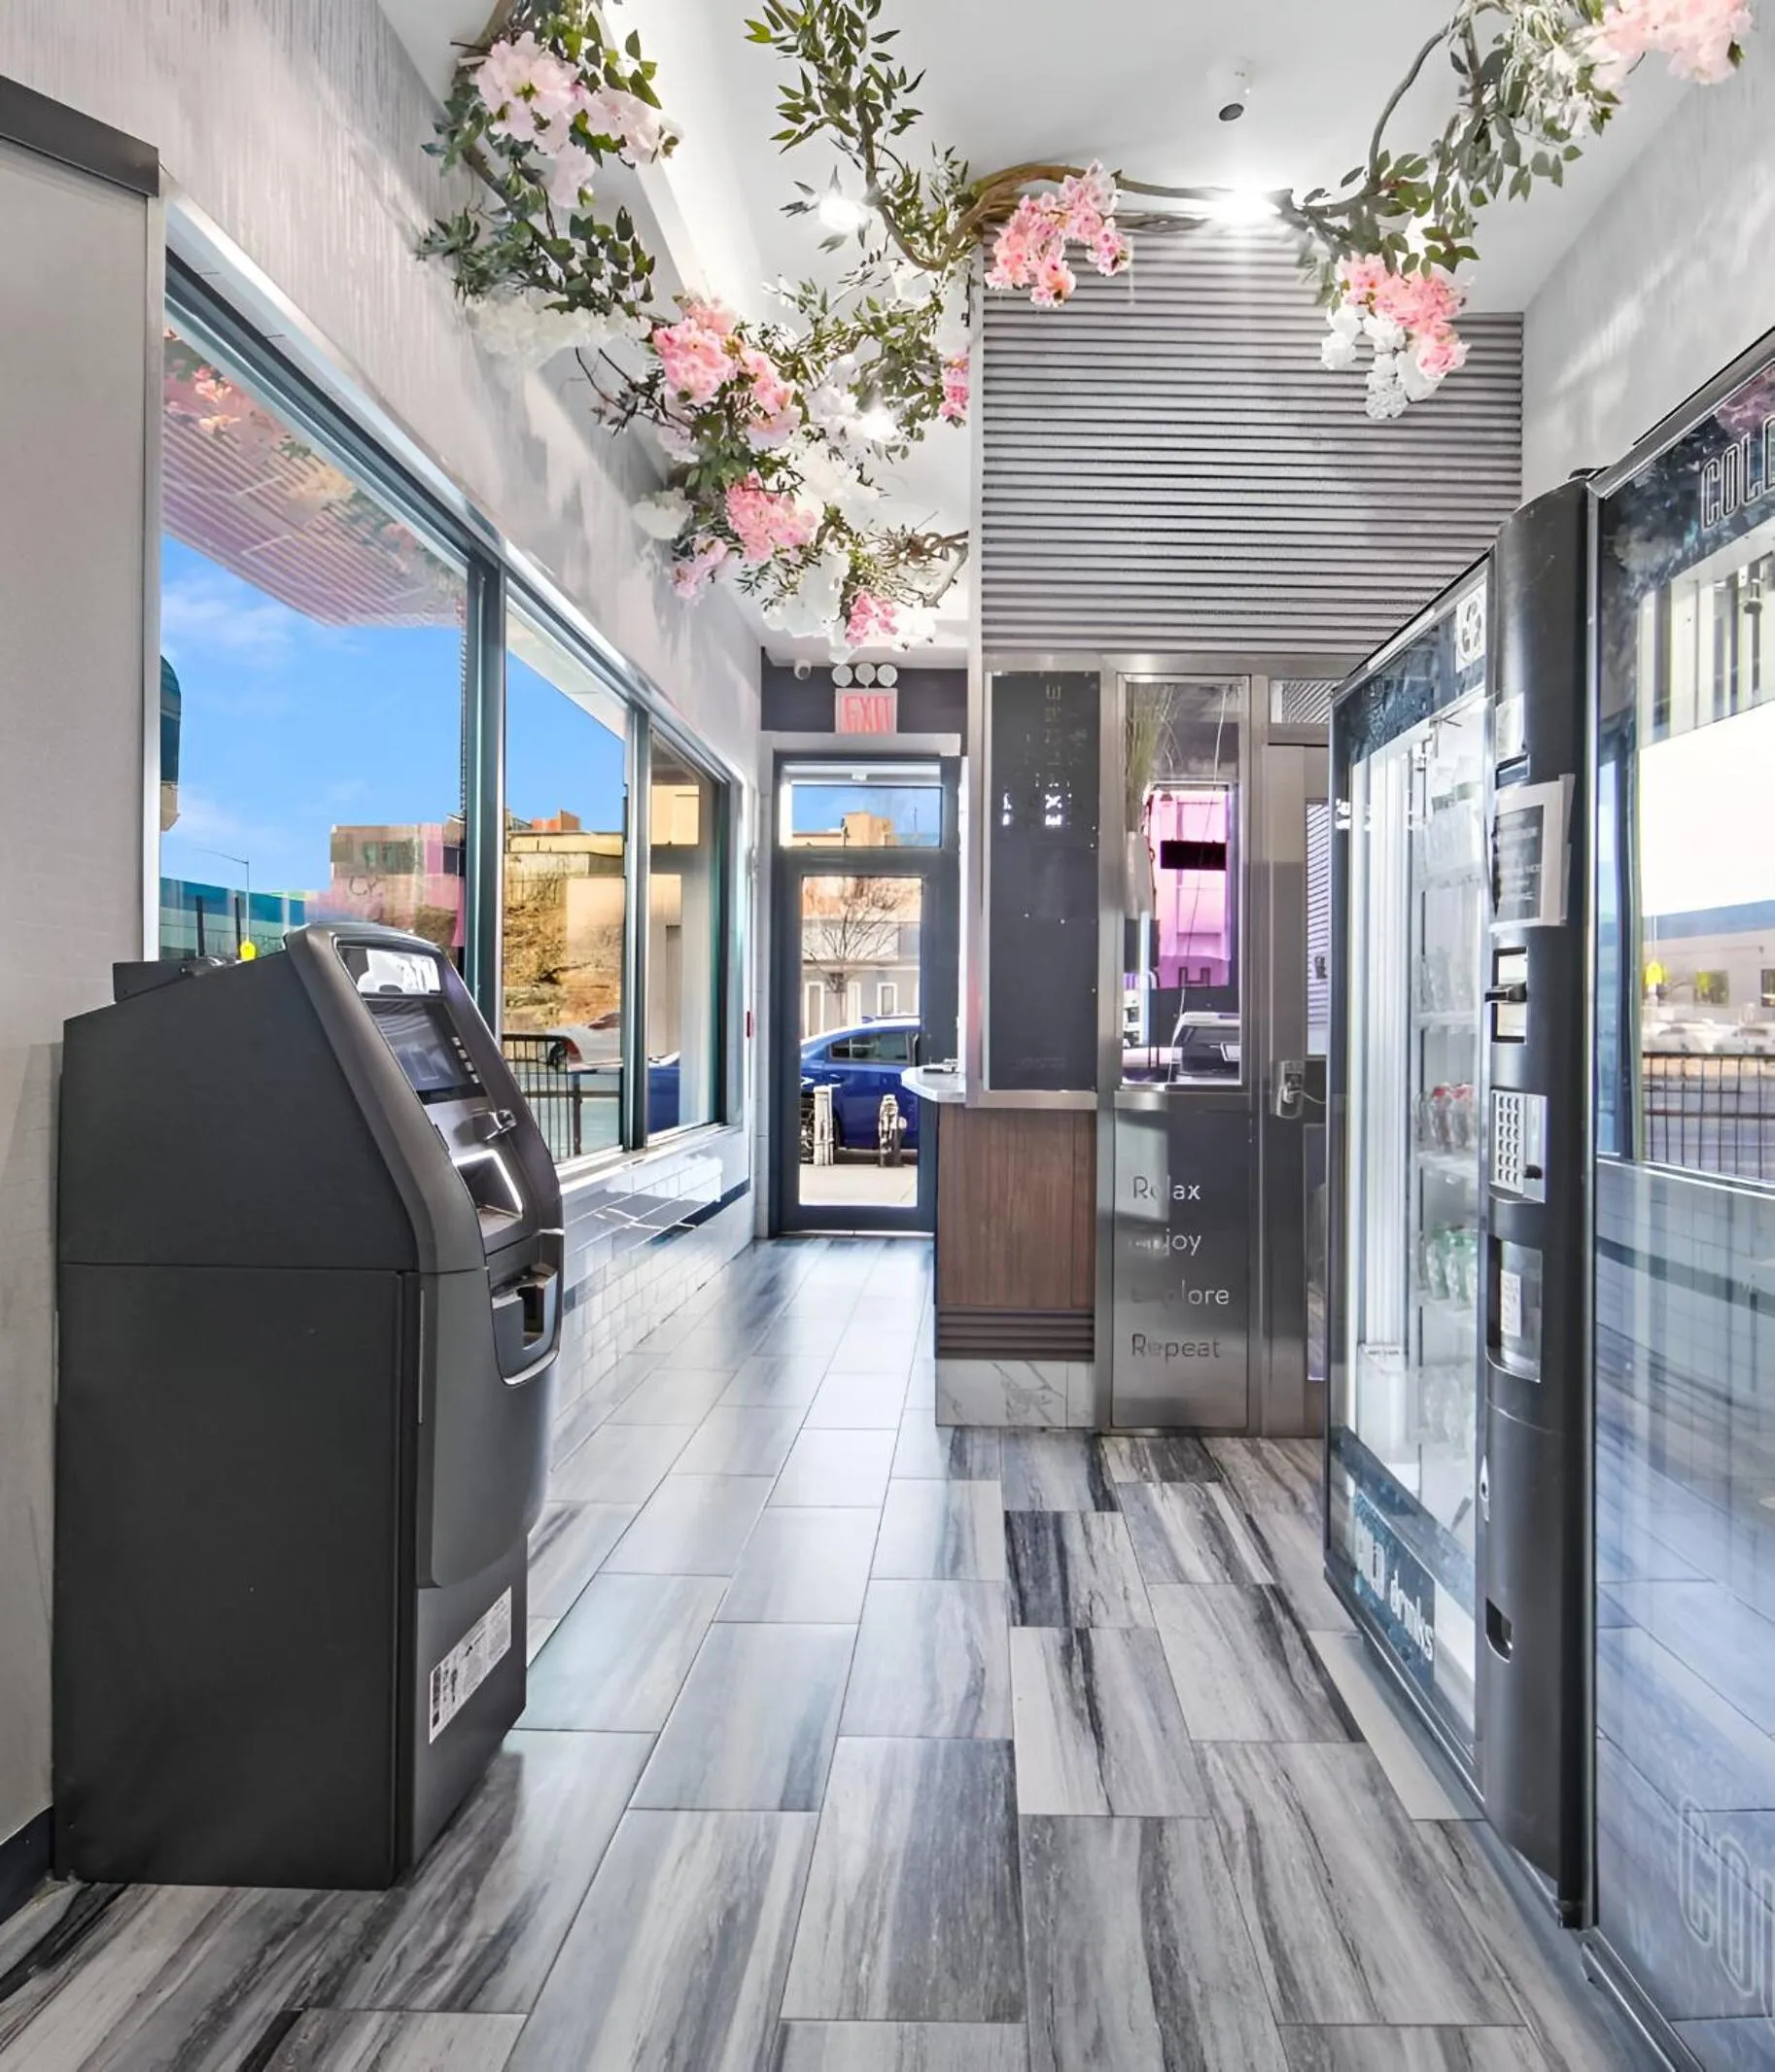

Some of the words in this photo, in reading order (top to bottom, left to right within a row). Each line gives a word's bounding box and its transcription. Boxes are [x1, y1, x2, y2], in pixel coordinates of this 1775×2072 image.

[844, 695, 893, 732] EXIT
[1132, 1227, 1201, 1256] joy
[1133, 1279, 1230, 1309] lore
[1131, 1332, 1220, 1364] Repeat
